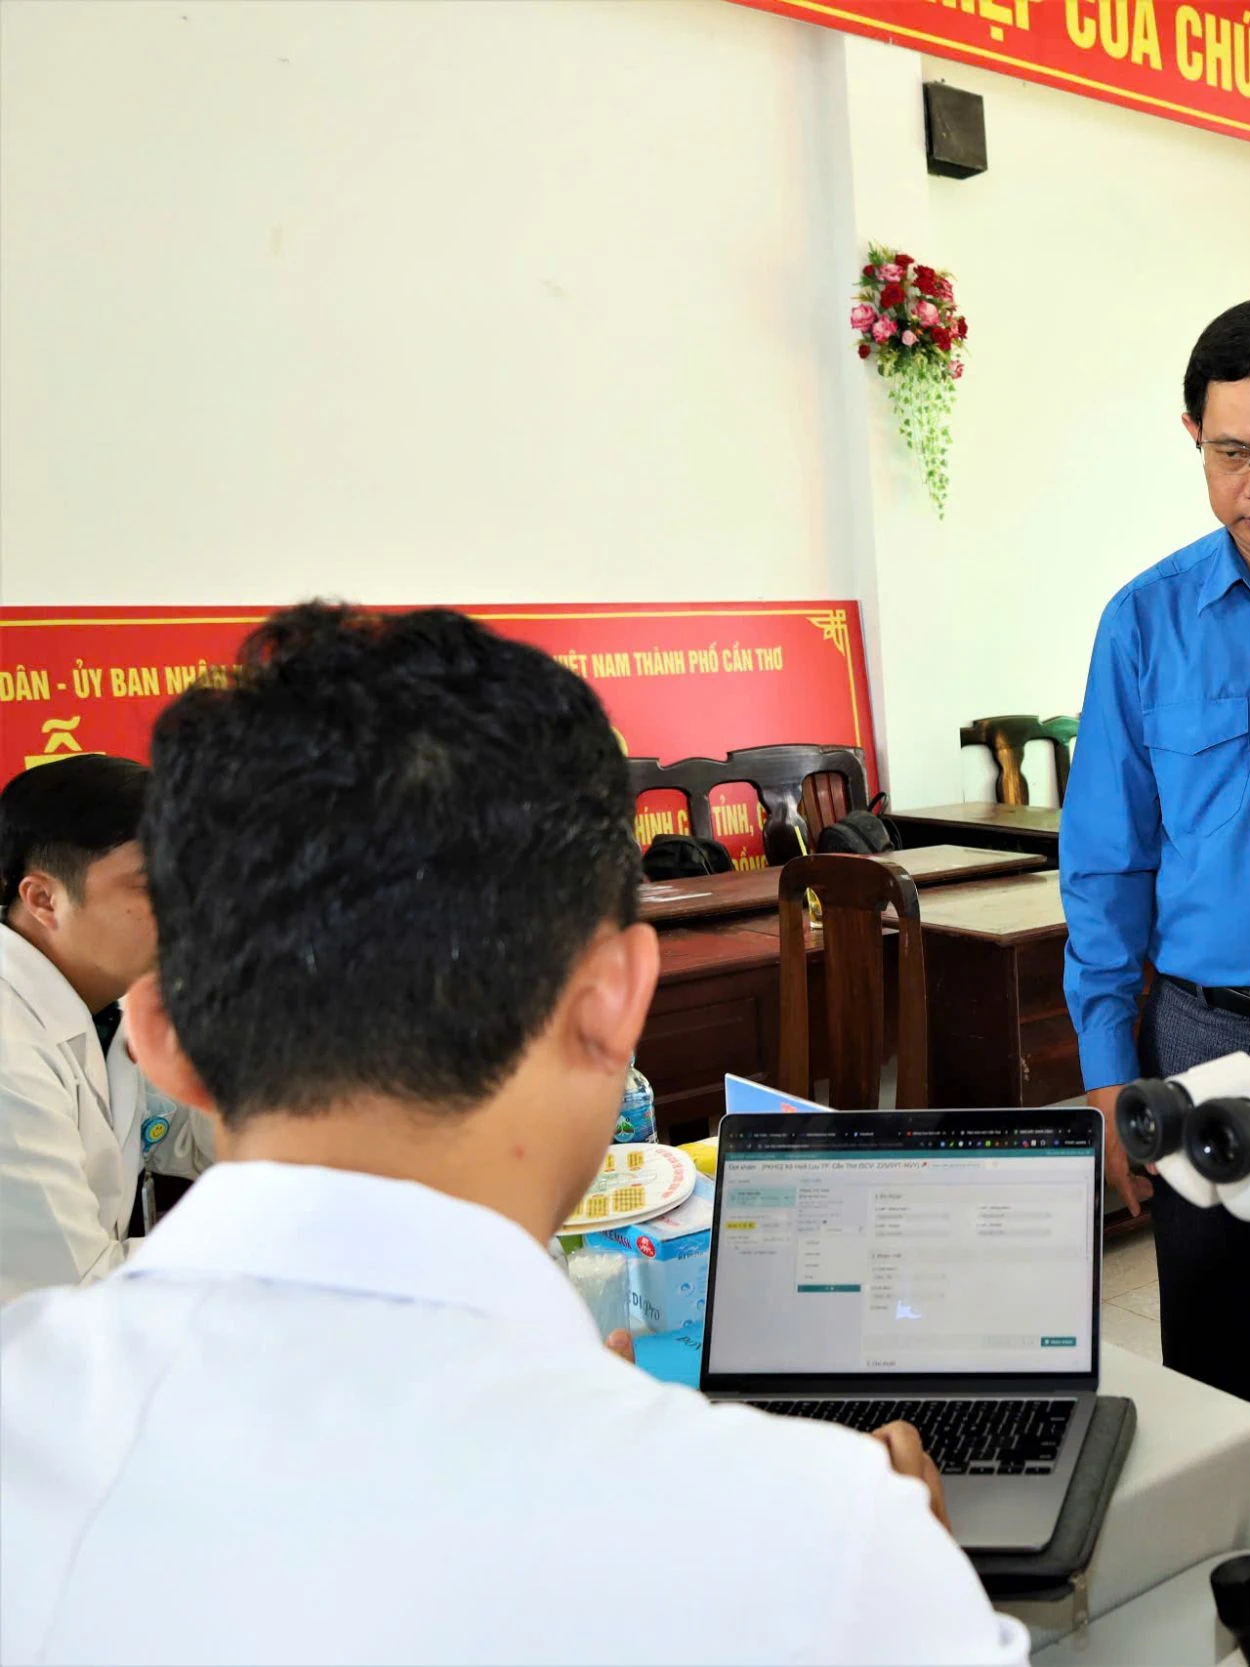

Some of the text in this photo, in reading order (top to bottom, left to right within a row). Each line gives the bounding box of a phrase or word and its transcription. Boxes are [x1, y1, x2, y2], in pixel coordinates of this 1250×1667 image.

[0, 664, 50, 702] DÂN
[73, 658, 102, 699] ỦY
[110, 667, 160, 697] BAN
[592, 651, 631, 678] NAM
[635, 645, 685, 676] THÀNH
[689, 640, 719, 674] PHỐ
[722, 640, 753, 672] CẦN
[756, 645, 783, 671] THƠ
[634, 805, 674, 845] HÍNH
[711, 794, 755, 837] TỈNH,
